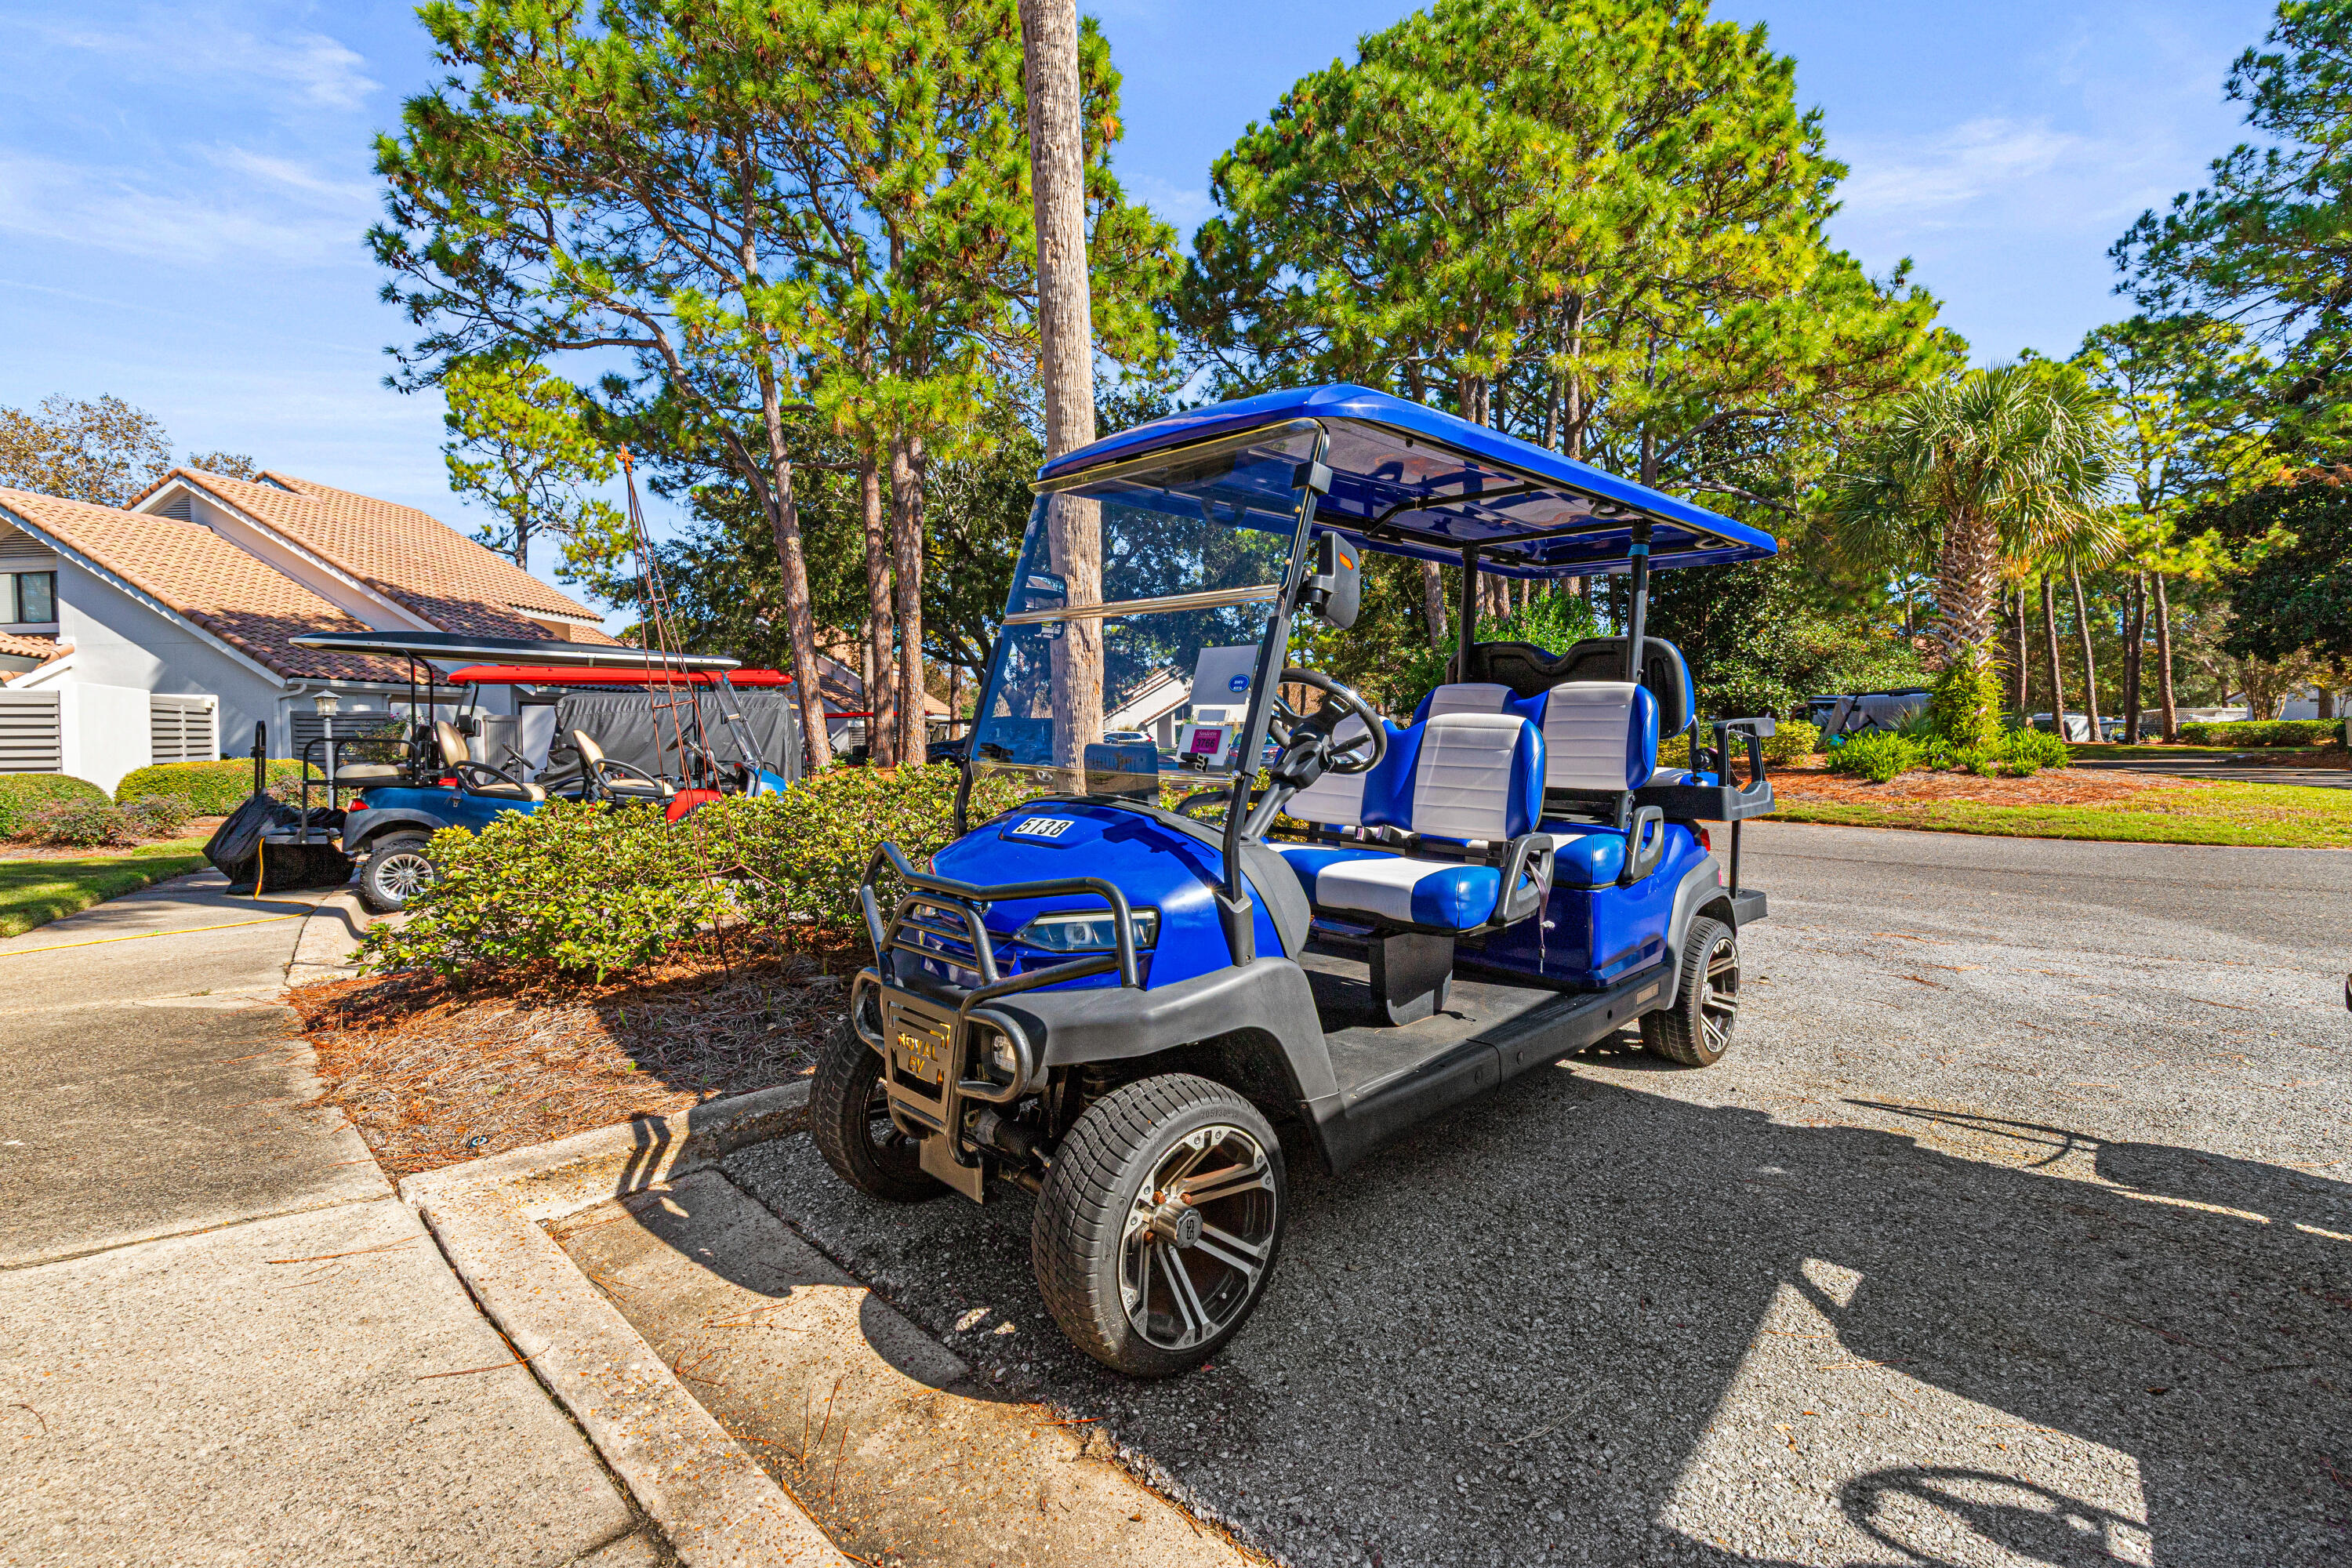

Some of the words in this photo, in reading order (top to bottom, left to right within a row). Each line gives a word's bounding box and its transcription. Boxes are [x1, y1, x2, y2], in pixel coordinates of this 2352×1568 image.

[1196, 739, 1215, 748] 3766
[1017, 818, 1069, 835] 5138
[897, 1029, 938, 1062] ROYAL
[908, 1054, 925, 1074] EV
[1186, 1219, 1194, 1240] SS
